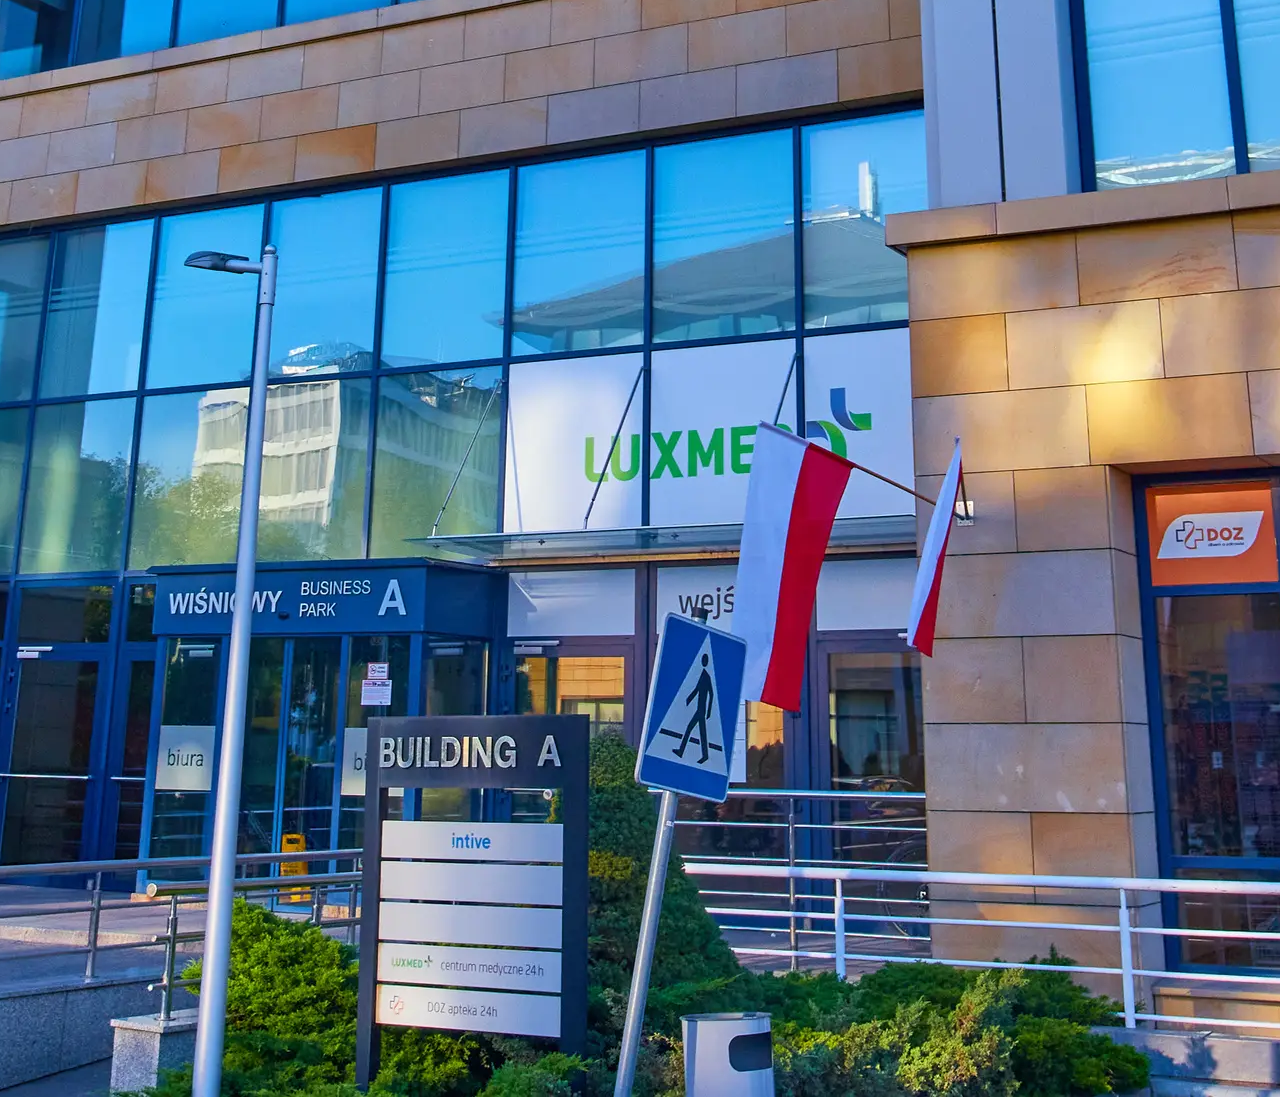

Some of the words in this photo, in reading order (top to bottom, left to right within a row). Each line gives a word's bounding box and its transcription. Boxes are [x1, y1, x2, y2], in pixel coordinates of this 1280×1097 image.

[584, 423, 793, 483] LUXME
[1207, 527, 1244, 541] DOZ
[301, 580, 371, 596] BUSINESS
[378, 579, 407, 616] A
[299, 602, 337, 618] PARK
[167, 748, 204, 767] biura
[380, 735, 517, 769] BUILDING
[537, 735, 562, 767] A
[451, 832, 491, 849] intive
[391, 957, 423, 969] LUXMED
[440, 960, 477, 972] centrum
[479, 962, 524, 976] medyczne
[428, 1001, 446, 1013] DOZ
[448, 1003, 478, 1016] apteka
[480, 1005, 498, 1018] 24h
